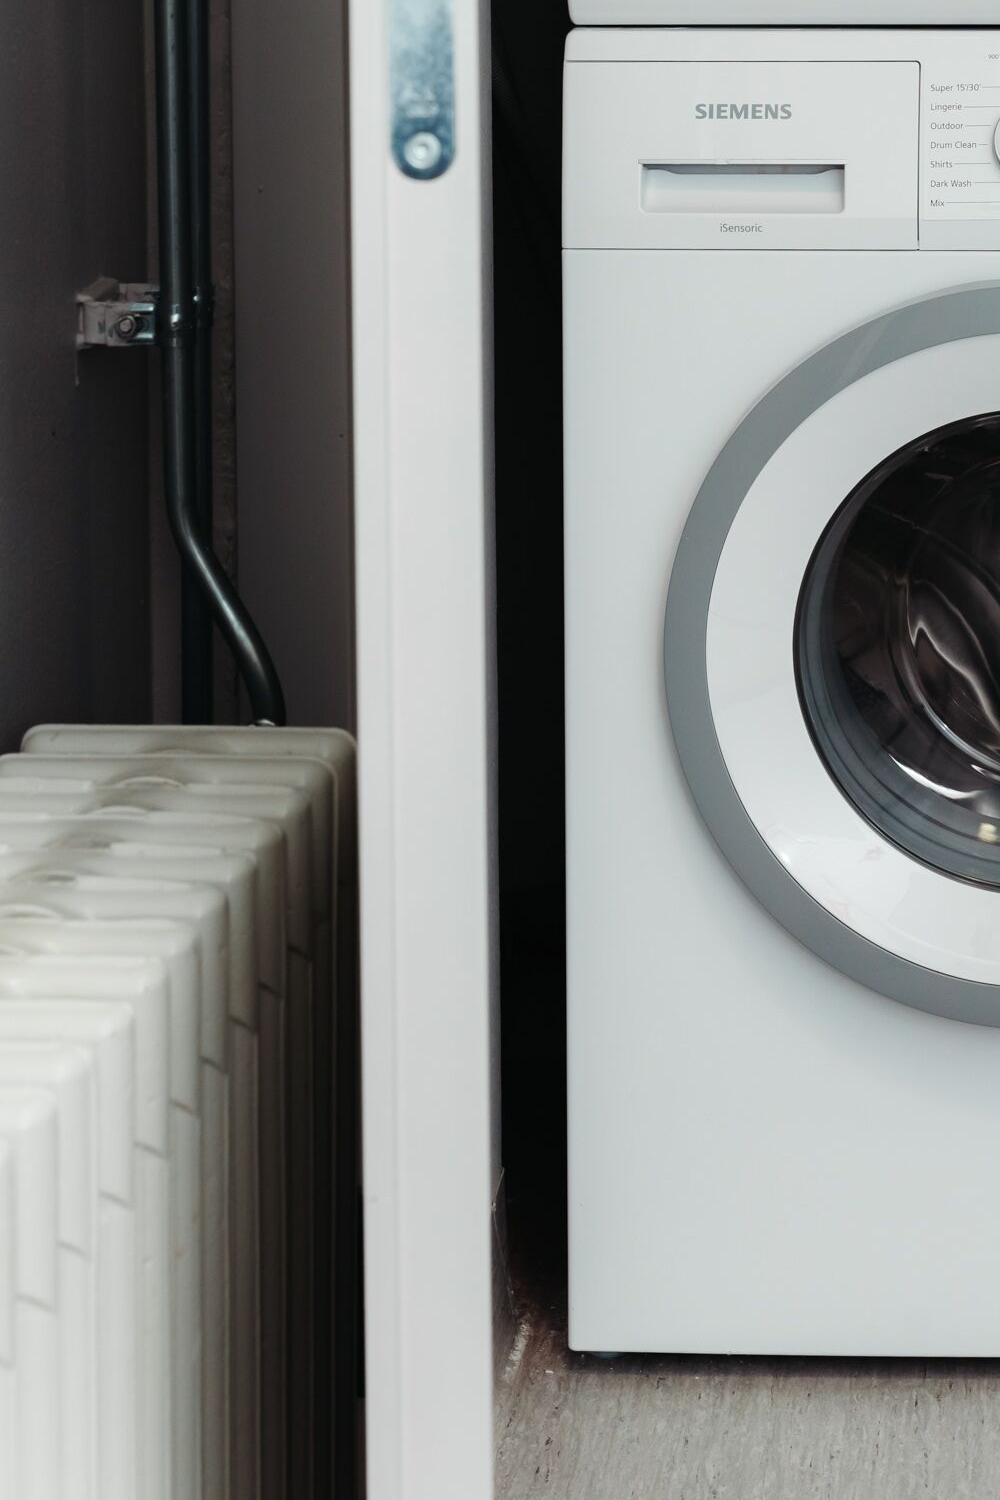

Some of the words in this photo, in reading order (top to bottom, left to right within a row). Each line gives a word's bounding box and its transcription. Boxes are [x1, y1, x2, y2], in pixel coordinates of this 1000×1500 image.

[930, 83, 954, 93] Super
[695, 103, 793, 120] SIEMENS
[930, 102, 963, 113] Lingerie
[930, 122, 964, 130] Outdoor
[930, 141, 953, 149] Drum
[954, 140, 977, 149] Clean
[930, 160, 953, 169] Shirts
[930, 179, 949, 188] Dark
[950, 179, 972, 188] Wash
[930, 199, 945, 207] Mix
[719, 222, 763, 233] iSensoric
